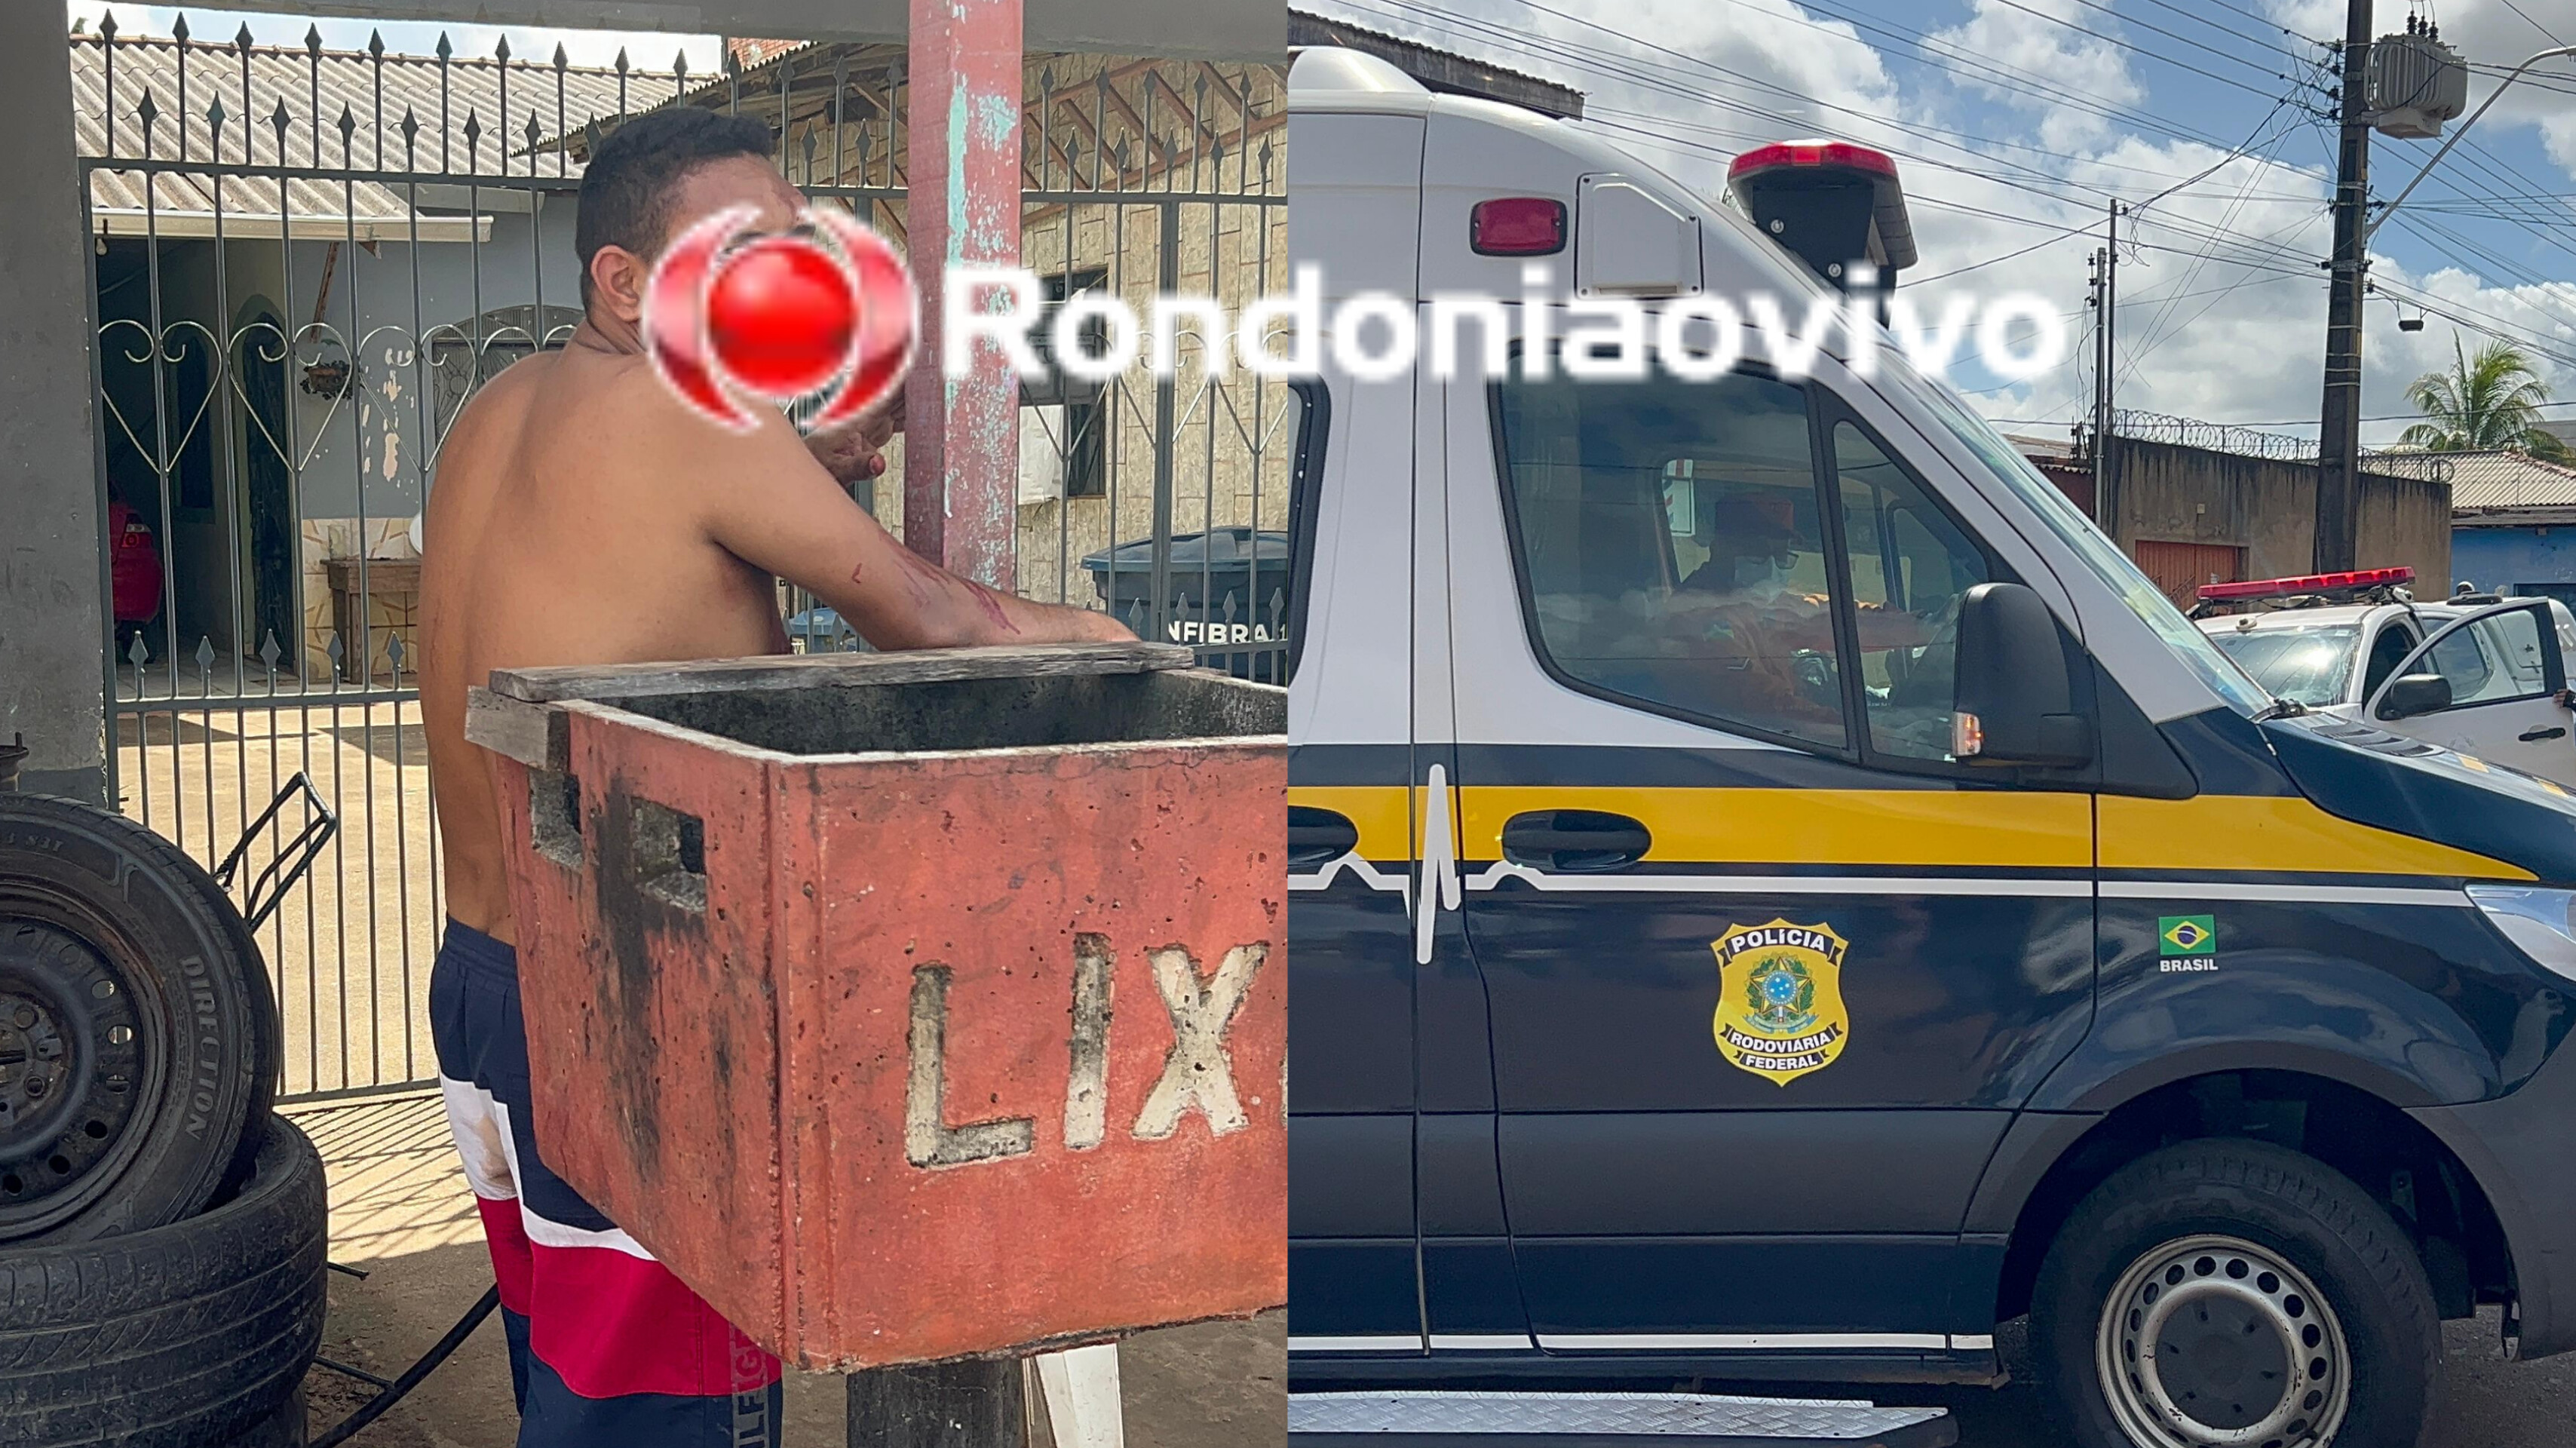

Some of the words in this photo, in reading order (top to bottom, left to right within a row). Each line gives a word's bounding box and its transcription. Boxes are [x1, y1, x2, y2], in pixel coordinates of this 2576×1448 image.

[1730, 928, 1825, 953] POLÍCIA
[2160, 959, 2219, 972] BRASIL
[179, 955, 220, 1141] DIRECTION
[905, 932, 1287, 1170] LIX
[1730, 1031, 1832, 1053] RODOVIÁRIA
[1745, 1054, 1818, 1070] FEDERAL
